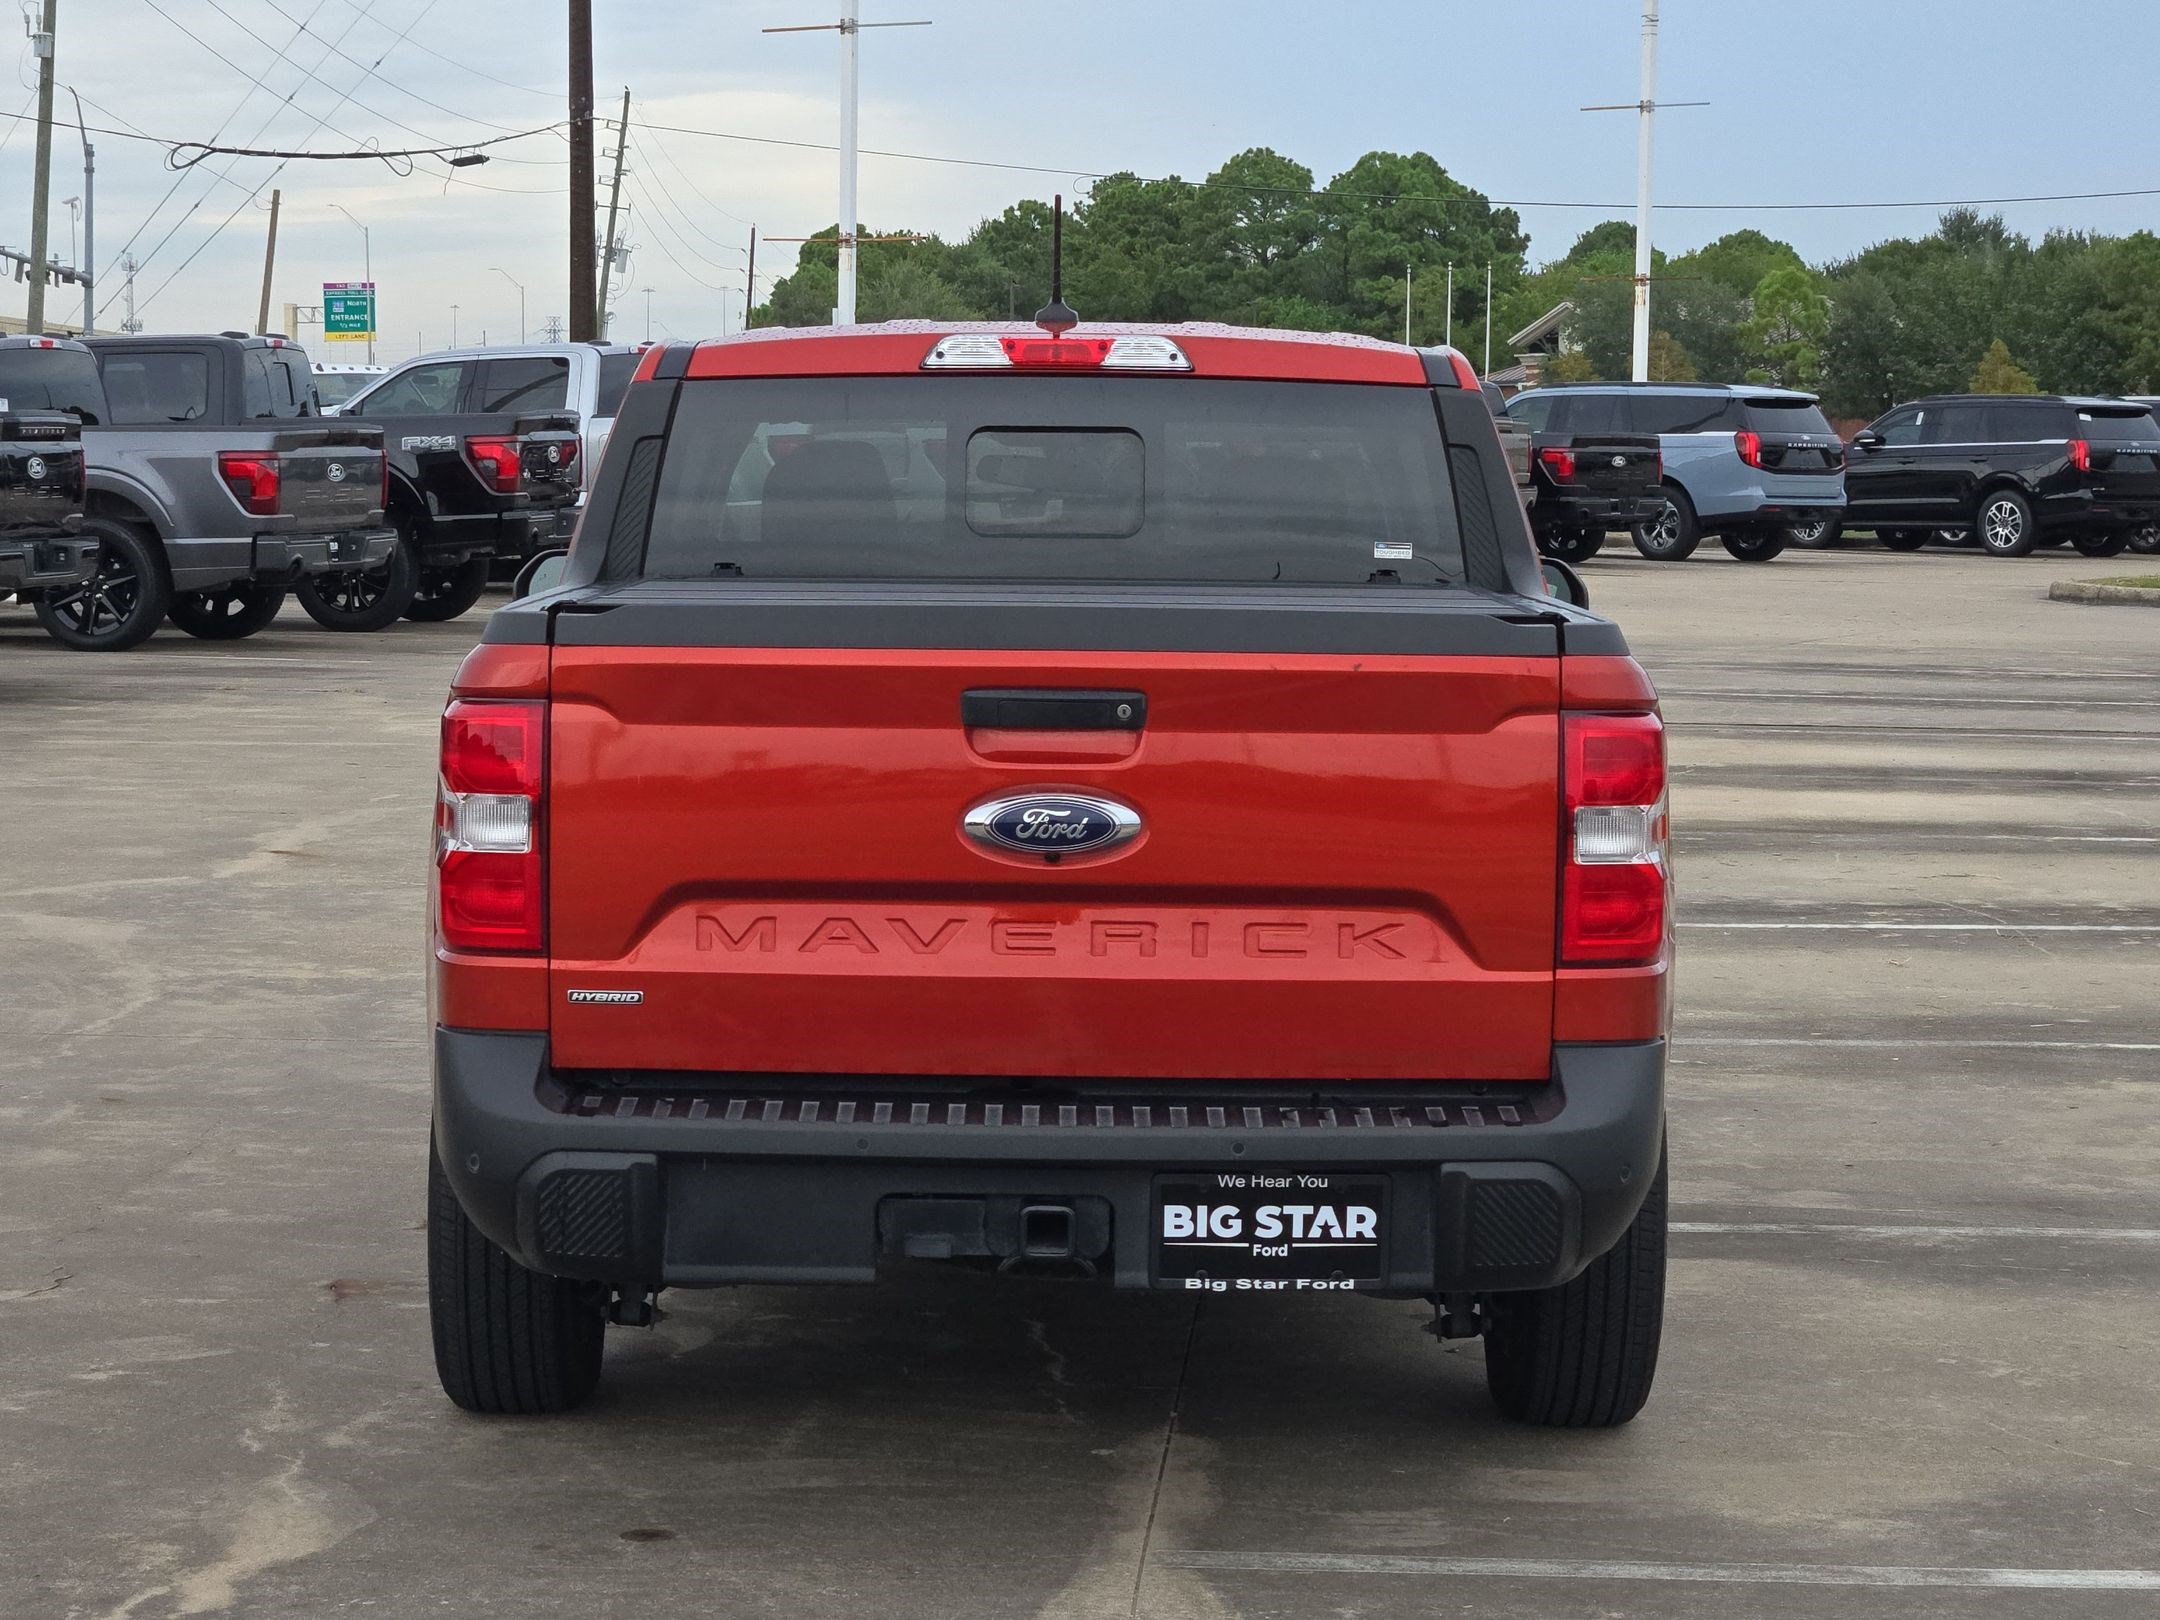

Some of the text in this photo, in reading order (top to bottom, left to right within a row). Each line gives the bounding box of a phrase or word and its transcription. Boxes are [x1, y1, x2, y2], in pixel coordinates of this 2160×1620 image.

[401, 435, 456, 450] FX4
[1015, 808, 1089, 839] Ford
[694, 915, 1406, 961] MAVERICK
[571, 992, 640, 1002] HYBRID
[1218, 1174, 1329, 1188] We Hear You
[1163, 1204, 1378, 1239] BIG STAR
[1252, 1243, 1288, 1257] Ford
[1184, 1278, 1355, 1292] Big Star Ford
